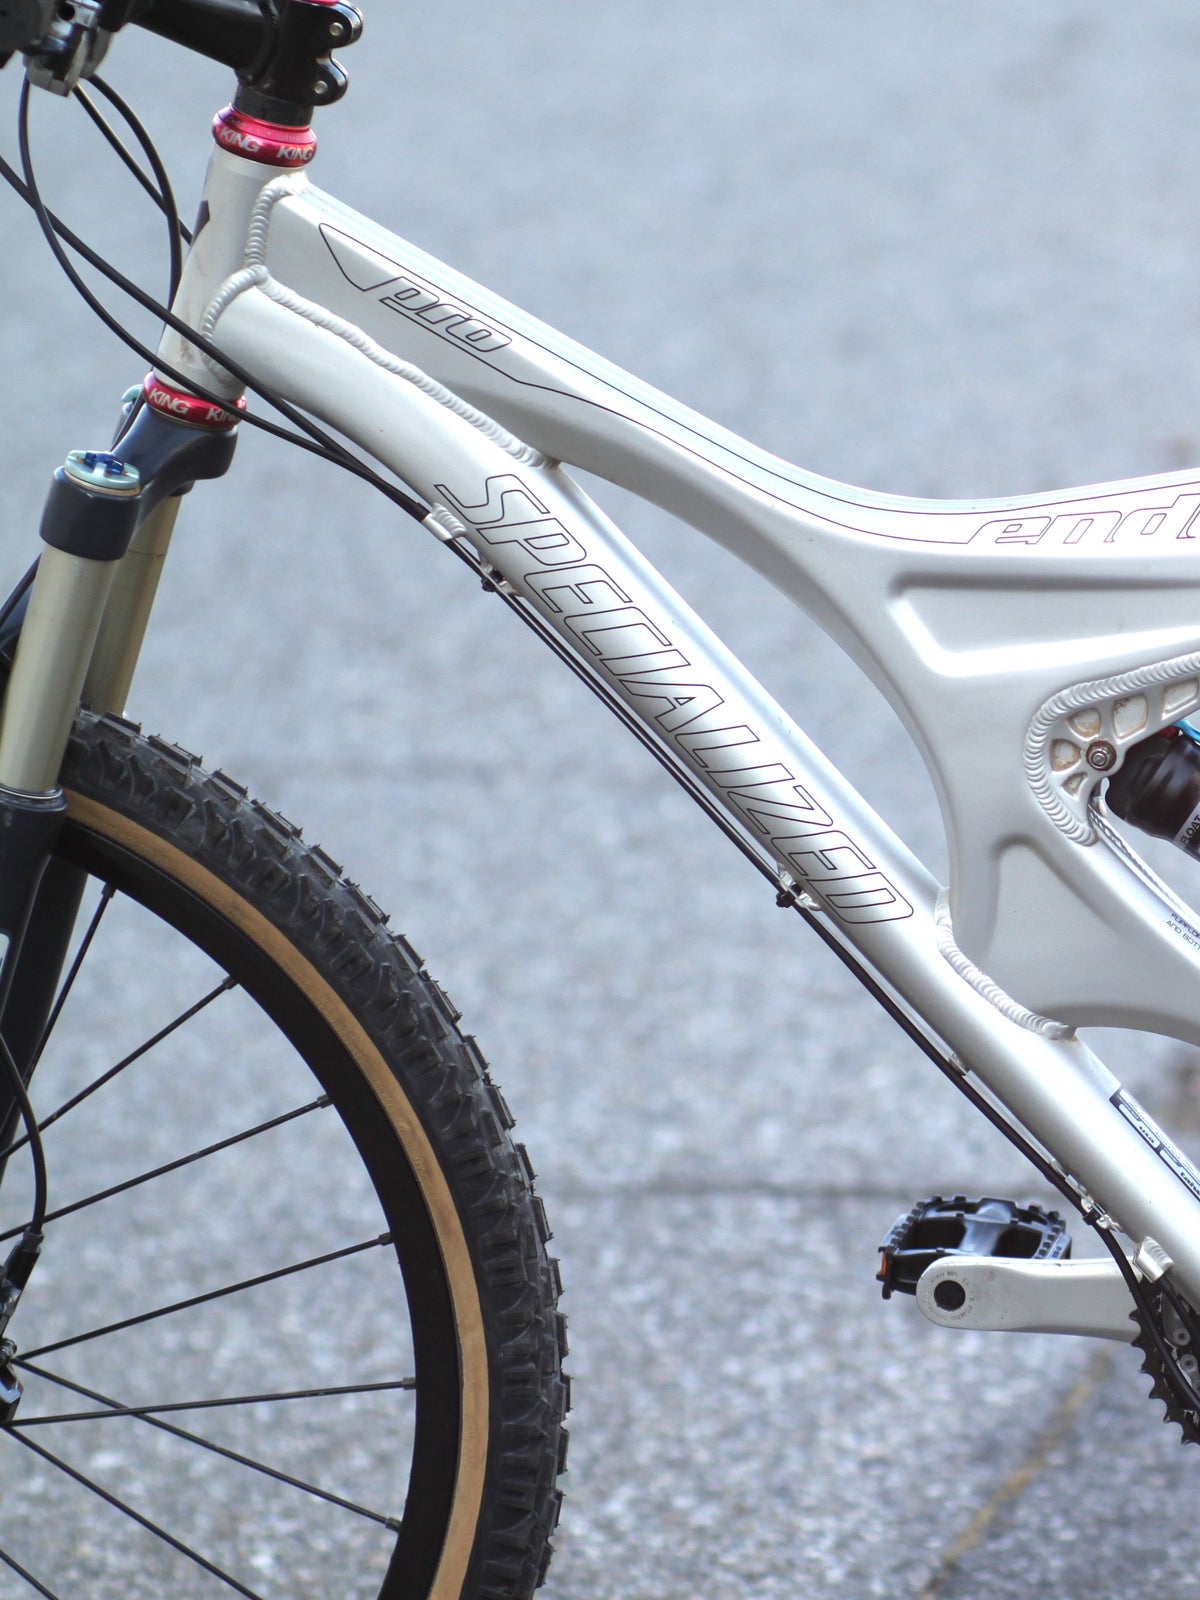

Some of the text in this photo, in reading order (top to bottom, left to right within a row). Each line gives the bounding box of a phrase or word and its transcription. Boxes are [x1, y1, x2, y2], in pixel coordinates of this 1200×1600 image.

[219, 126, 260, 153] KING
[276, 145, 314, 160] KING
[378, 275, 513, 353] pro
[149, 388, 191, 414] KING
[205, 406, 240, 422] KIN
[433, 473, 914, 925] SPECIALIZED
[1165, 919, 1182, 935] AND
